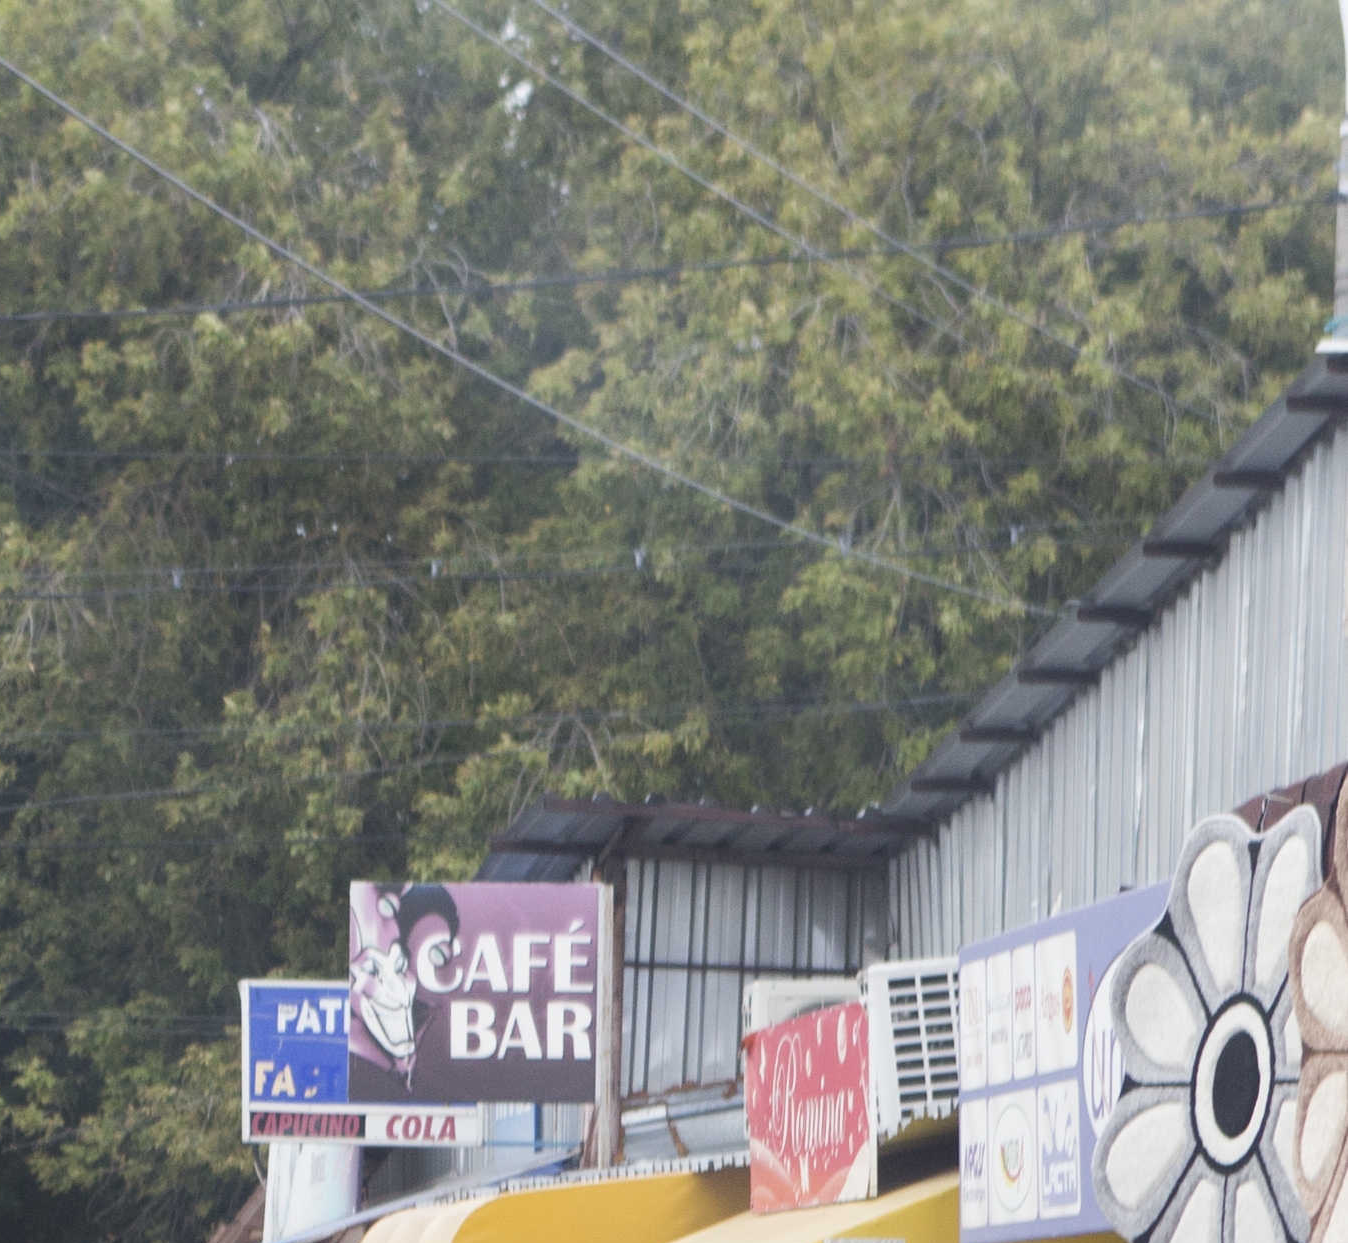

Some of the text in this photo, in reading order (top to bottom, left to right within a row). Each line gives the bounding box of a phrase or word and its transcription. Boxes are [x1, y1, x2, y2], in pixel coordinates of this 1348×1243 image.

[416, 918, 595, 994] CAFÉ
[449, 1001, 593, 1060] BAR
[771, 1032, 846, 1158] Romina
[250, 1112, 360, 1138] CAPUCINO
[385, 1114, 457, 1141] COLA
